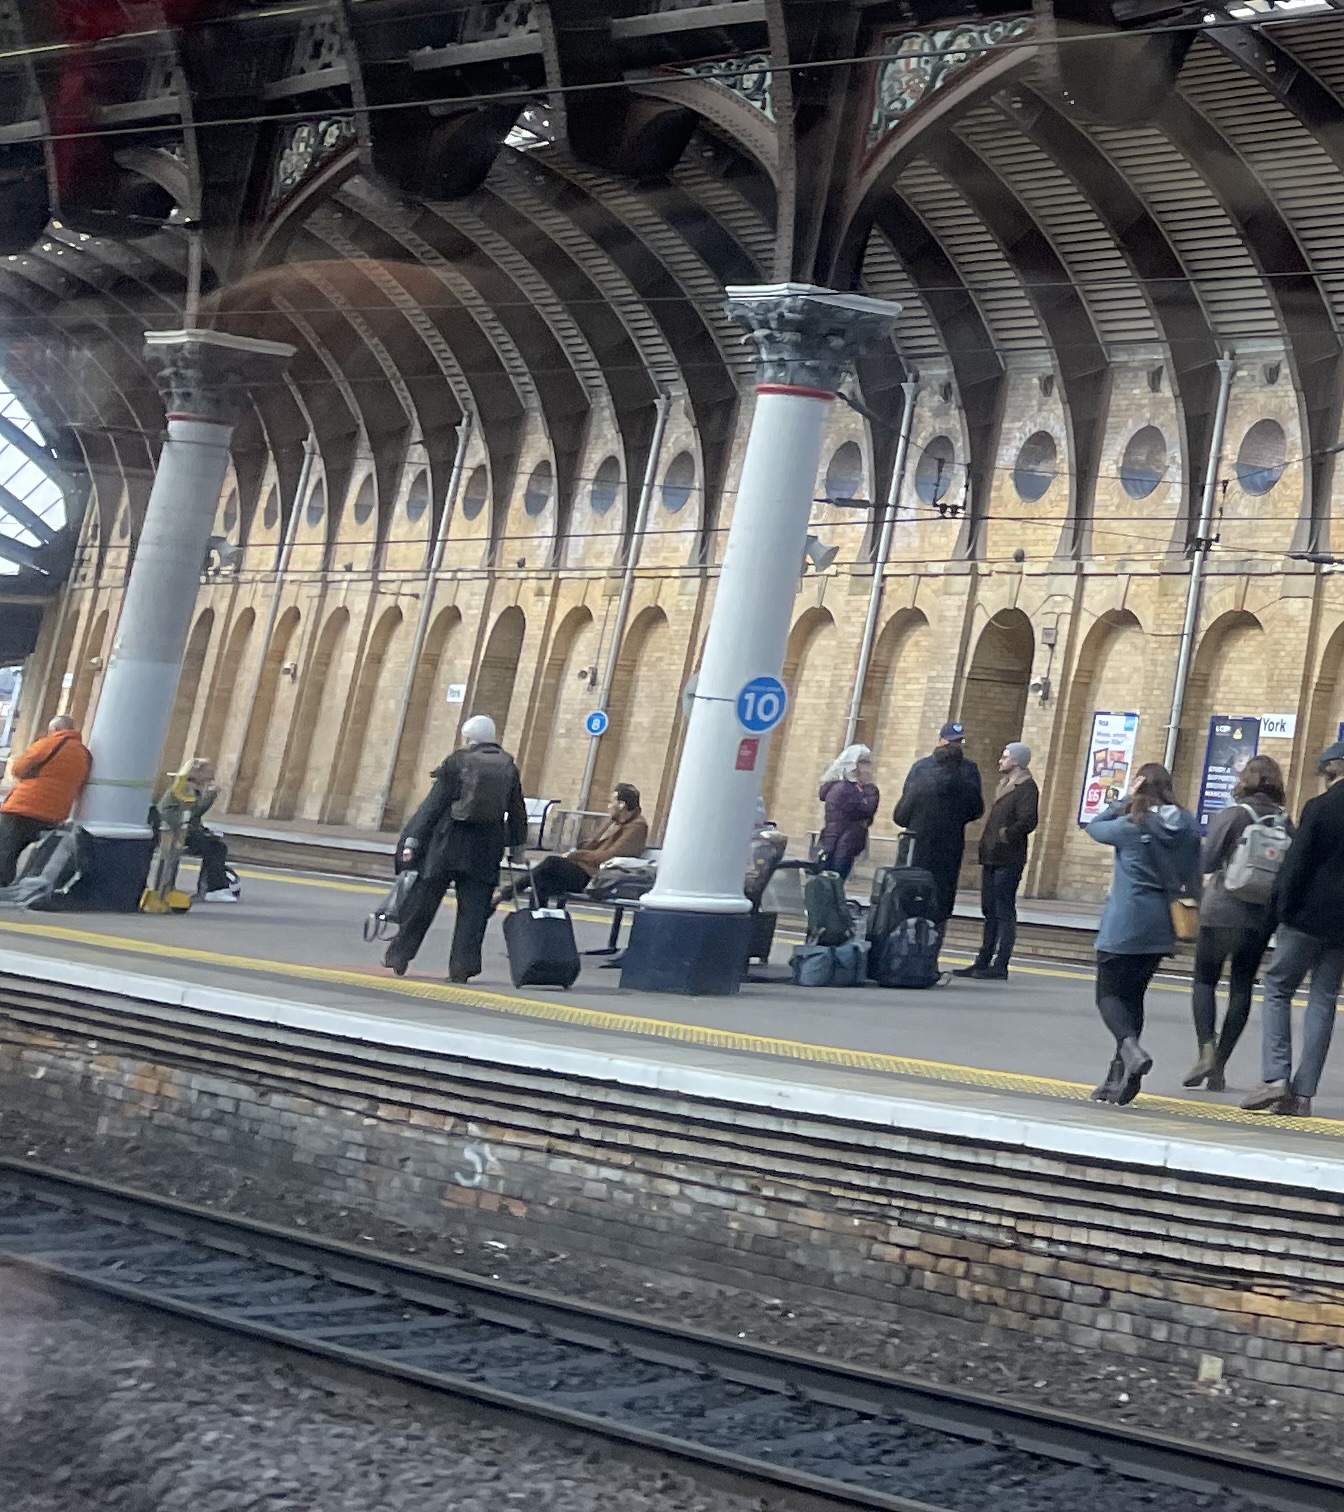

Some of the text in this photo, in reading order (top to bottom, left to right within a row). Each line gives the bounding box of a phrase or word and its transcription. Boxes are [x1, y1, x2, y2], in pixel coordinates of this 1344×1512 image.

[743, 692, 780, 722] 10
[591, 718, 601, 731] 8
[1262, 717, 1287, 733] York
